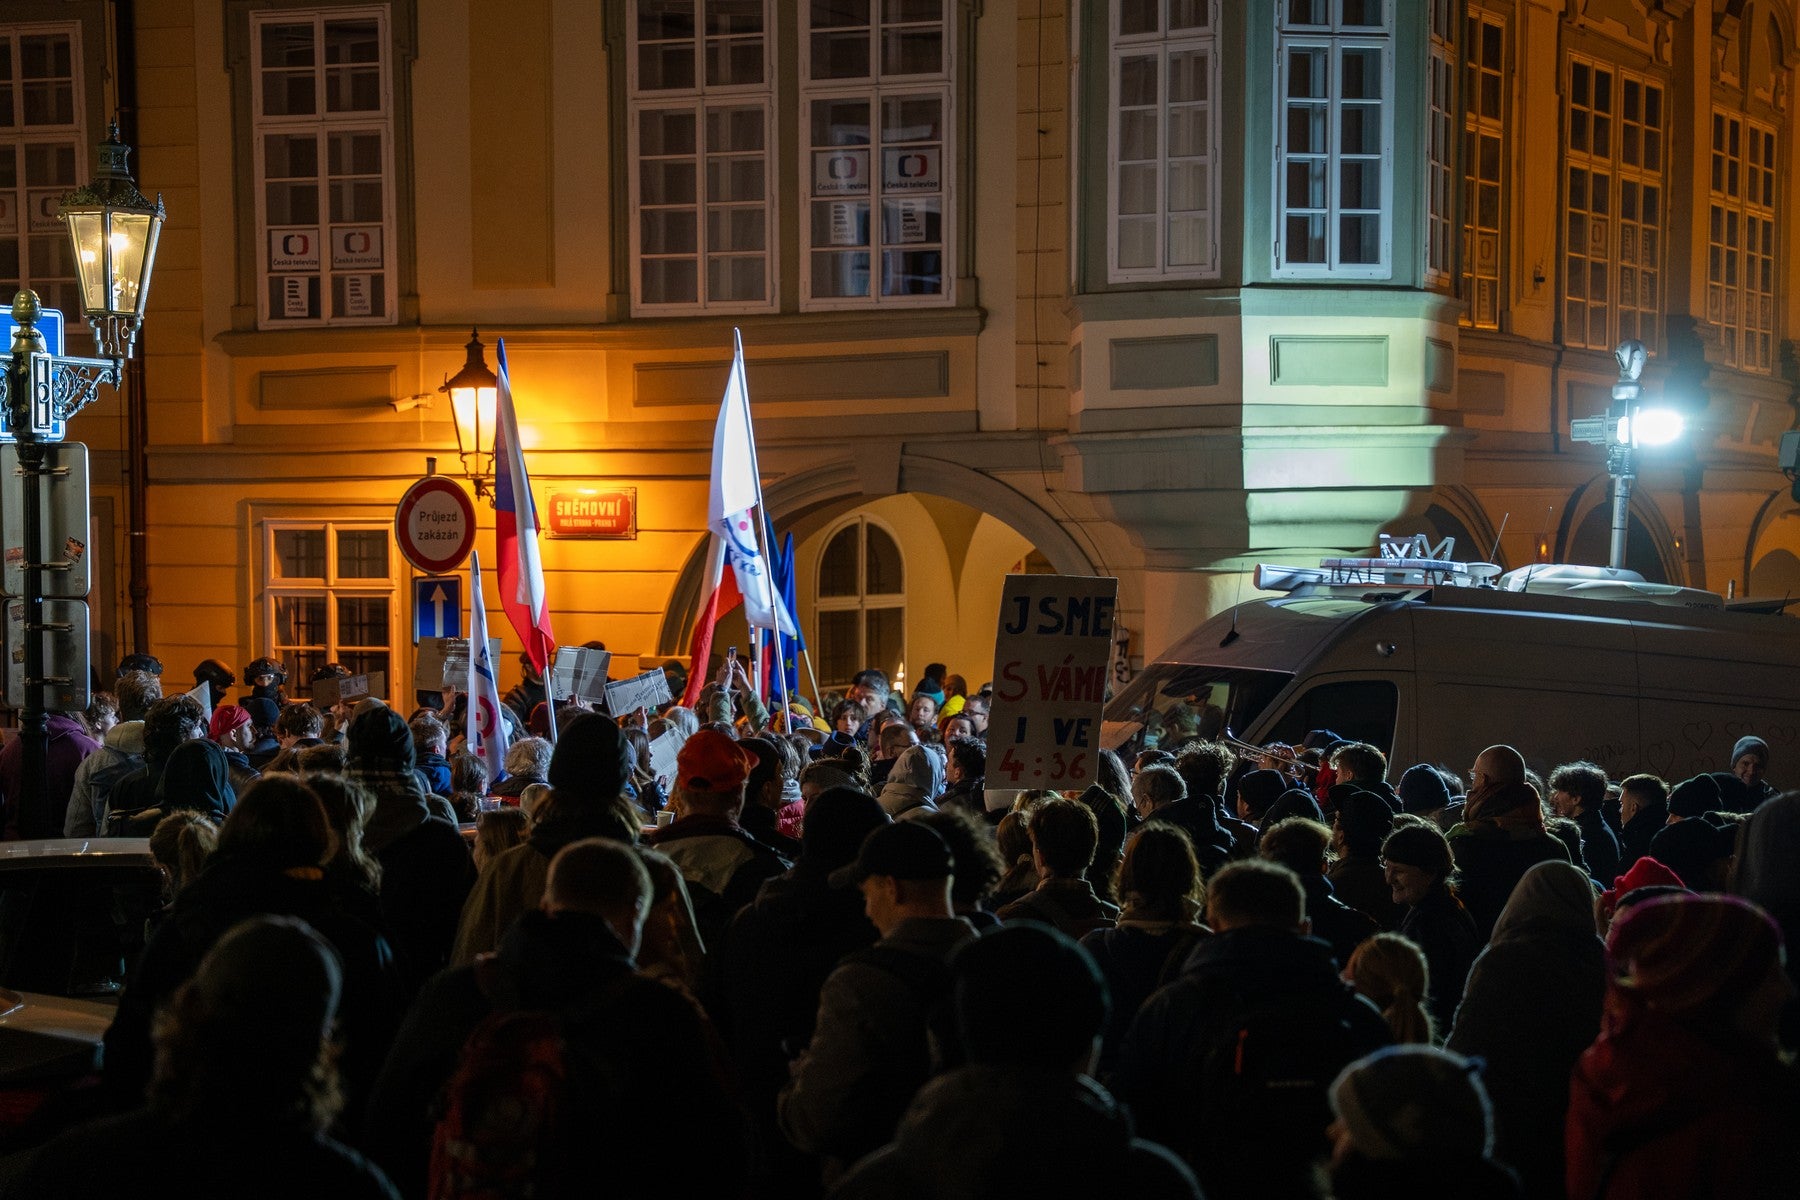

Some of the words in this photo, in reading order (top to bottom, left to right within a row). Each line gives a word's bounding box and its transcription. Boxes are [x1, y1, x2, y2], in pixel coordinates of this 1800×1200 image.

[886, 181, 908, 189] Česká
[909, 180, 938, 188] televize
[273, 258, 292, 266] Česká
[293, 258, 318, 266] televize
[556, 498, 622, 517] SNĚMOVNÍ
[419, 510, 458, 525] Průjezd
[418, 529, 459, 541] zakázán
[1005, 595, 1116, 638] JSME
[998, 661, 1029, 702] S
[1036, 653, 1106, 704] VÁMI
[1014, 716, 1028, 744] I
[1053, 717, 1092, 748] VE
[999, 748, 1087, 782] 4:36
